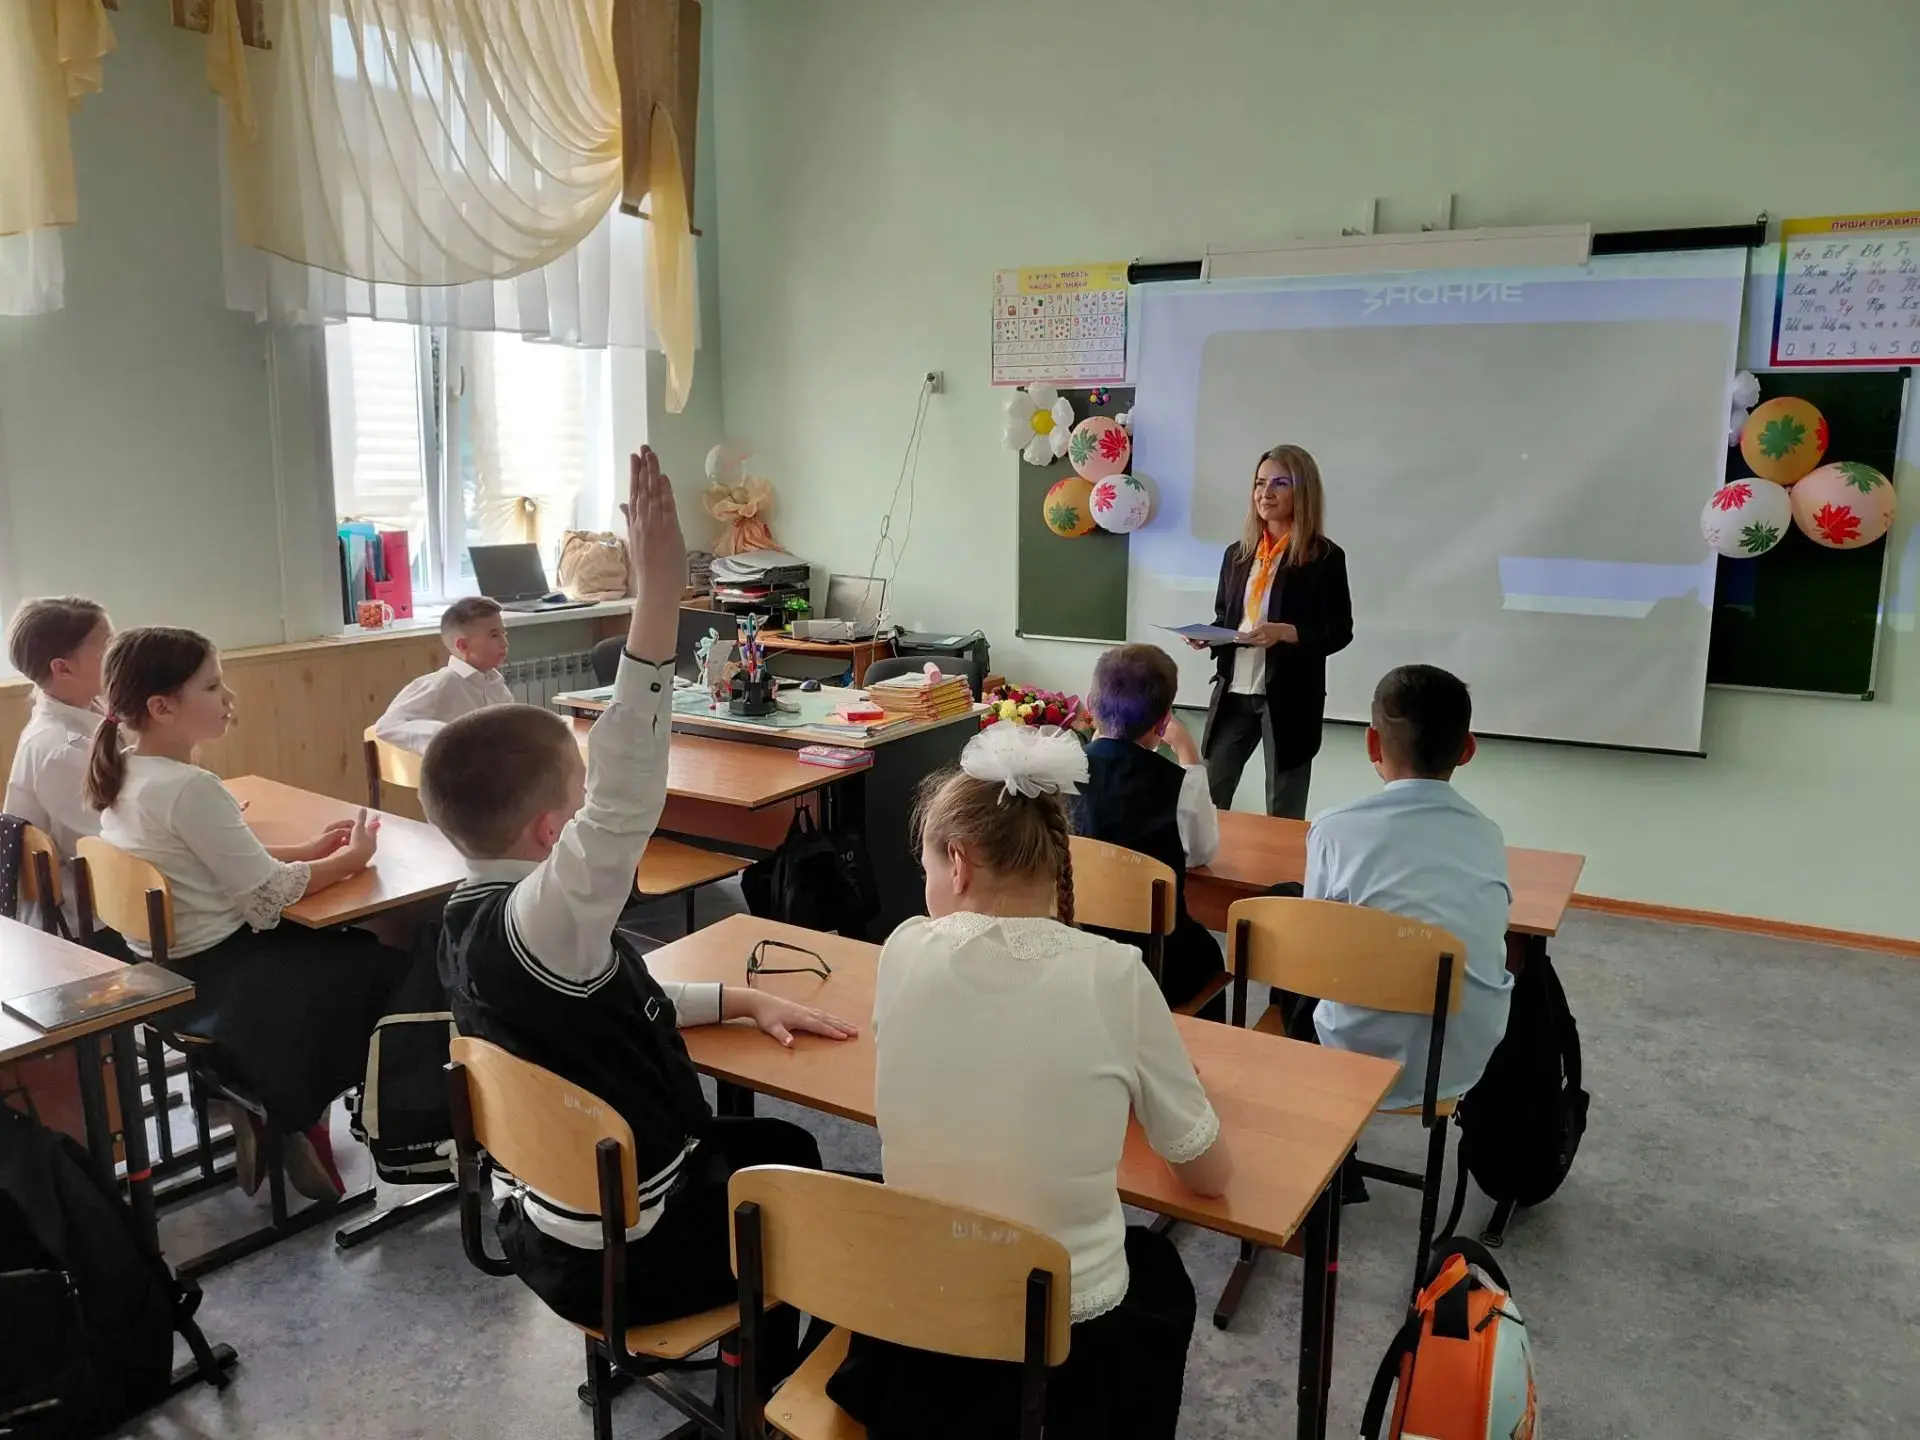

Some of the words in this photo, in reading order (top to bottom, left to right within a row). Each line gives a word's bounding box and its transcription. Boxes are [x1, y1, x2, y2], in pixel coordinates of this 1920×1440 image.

[1831, 219, 1866, 230] ПИШИ
[1870, 216, 1920, 227] ПРАВИЛ
[1822, 244, 1850, 259] Бб
[1860, 243, 1884, 257] Вв
[1060, 271, 1089, 279] ПИСАТЬ
[1799, 263, 1829, 277] Жж
[1789, 282, 1818, 296] Мм
[1829, 279, 1854, 295] Нн
[1867, 279, 1886, 294] Оо
[1100, 316, 1110, 326] 10
[1785, 342, 1796, 356] 0
[1809, 342, 1816, 356] 1
[1826, 342, 1837, 355] 2
[1846, 341, 1858, 355] 3
[1869, 341, 1879, 354] 4
[1888, 341, 1900, 354] 5
[1911, 340, 1920, 353] 6
